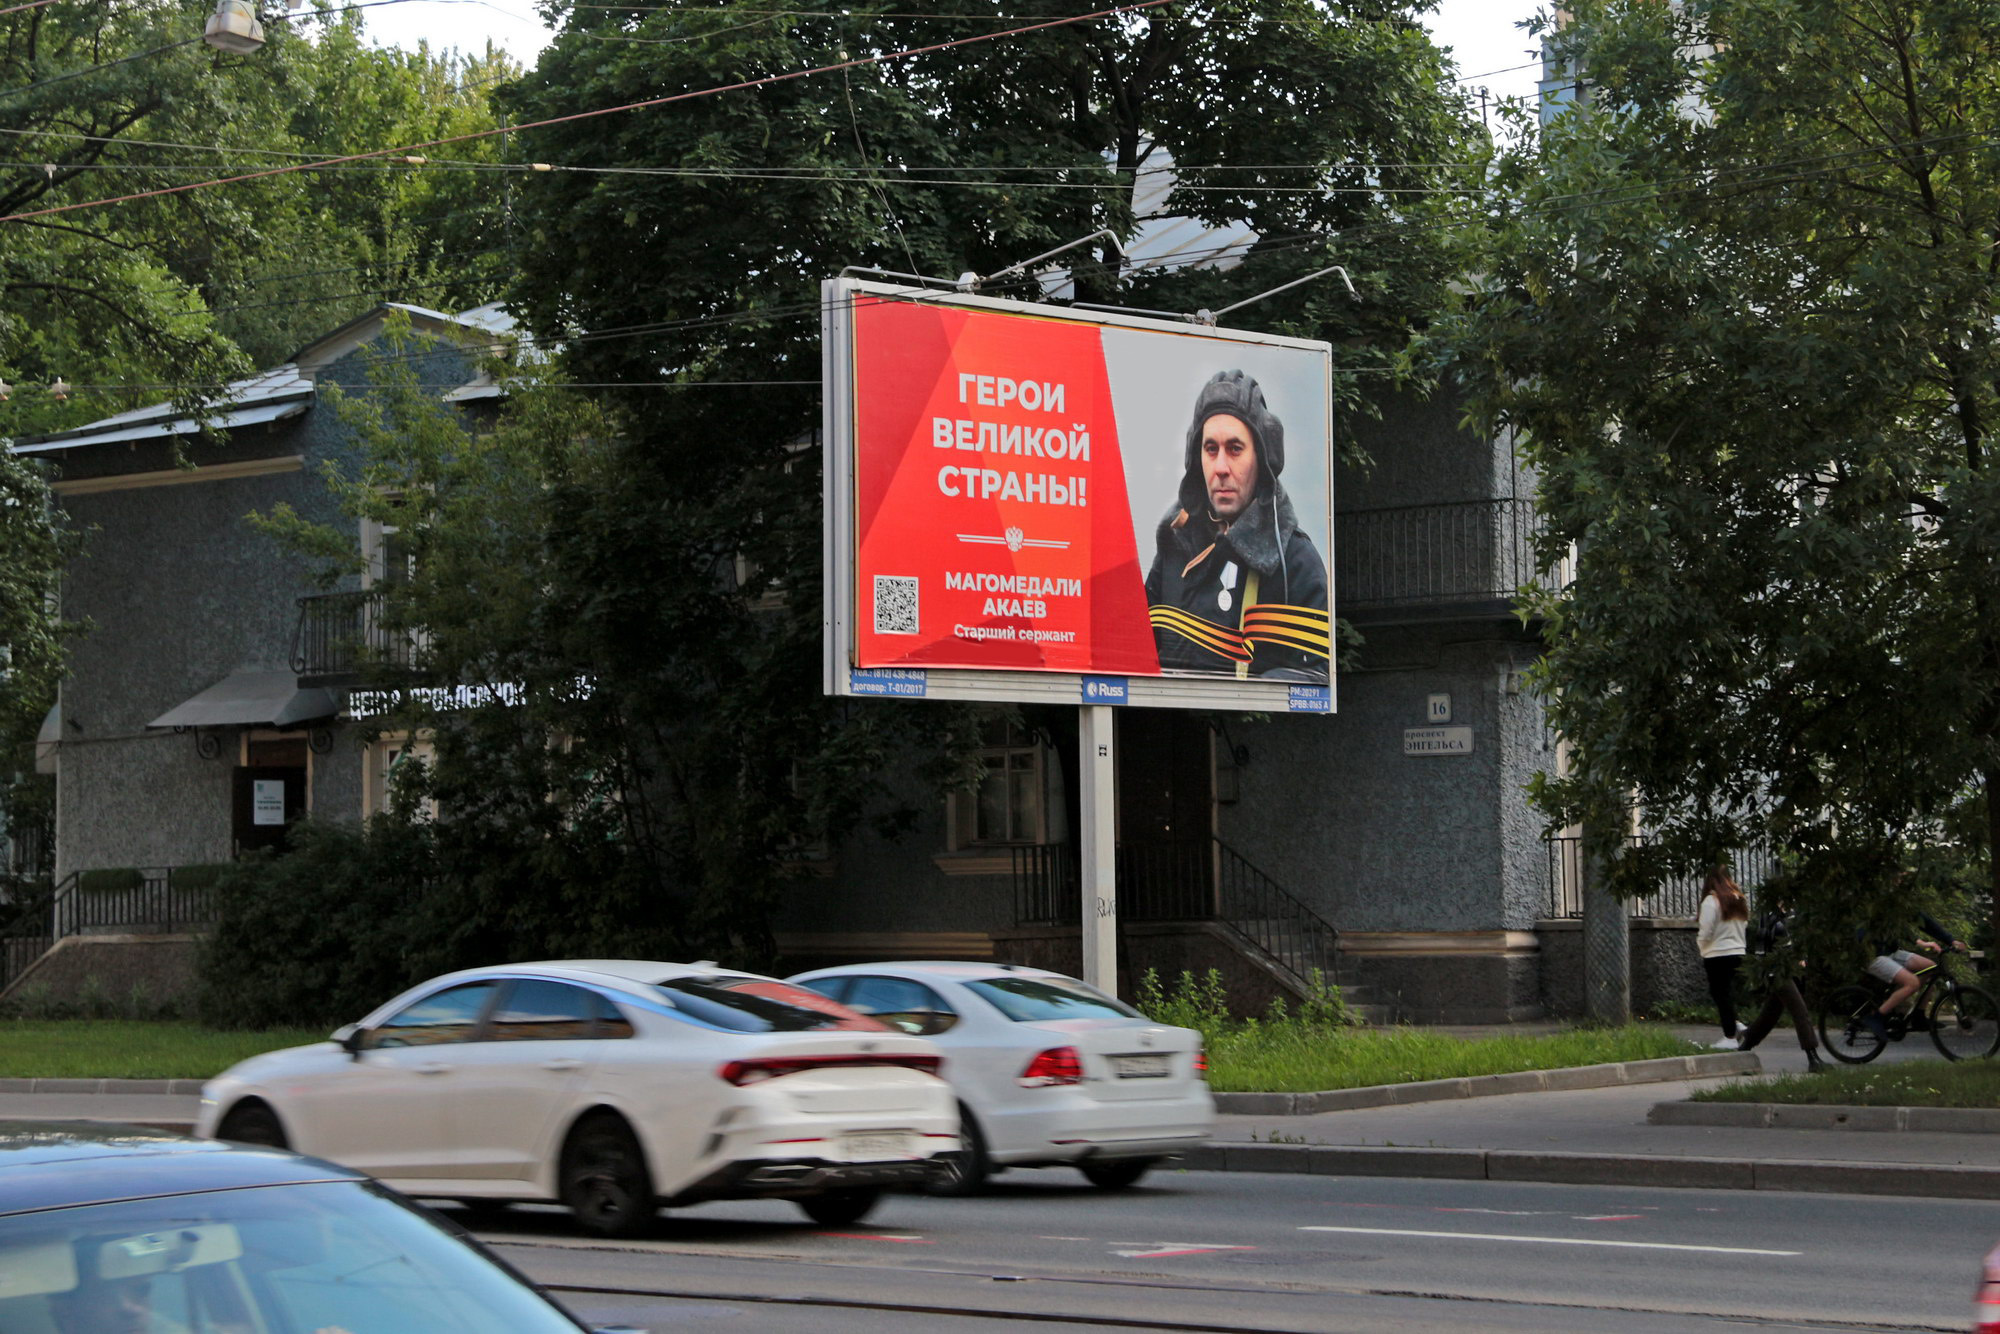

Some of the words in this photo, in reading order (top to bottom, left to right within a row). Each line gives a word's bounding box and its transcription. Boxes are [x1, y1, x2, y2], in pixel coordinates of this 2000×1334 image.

[959, 372, 1065, 413] ГЕРОИ
[932, 417, 1090, 462] ВЕЛИКОЙ
[937, 465, 1087, 507] СТРАНЫ!
[945, 571, 1082, 598] МАГОМЕДАЛИ
[982, 598, 1047, 619] АКАЕВ
[954, 623, 1016, 641] Старший
[1018, 631, 1076, 644] сержант
[853, 683, 886, 693] договор:
[1099, 682, 1124, 697] Russ
[1433, 702, 1446, 715] 16
[1405, 731, 1445, 739] проспект
[1405, 740, 1464, 751] ЭНГЕЛЬСА
